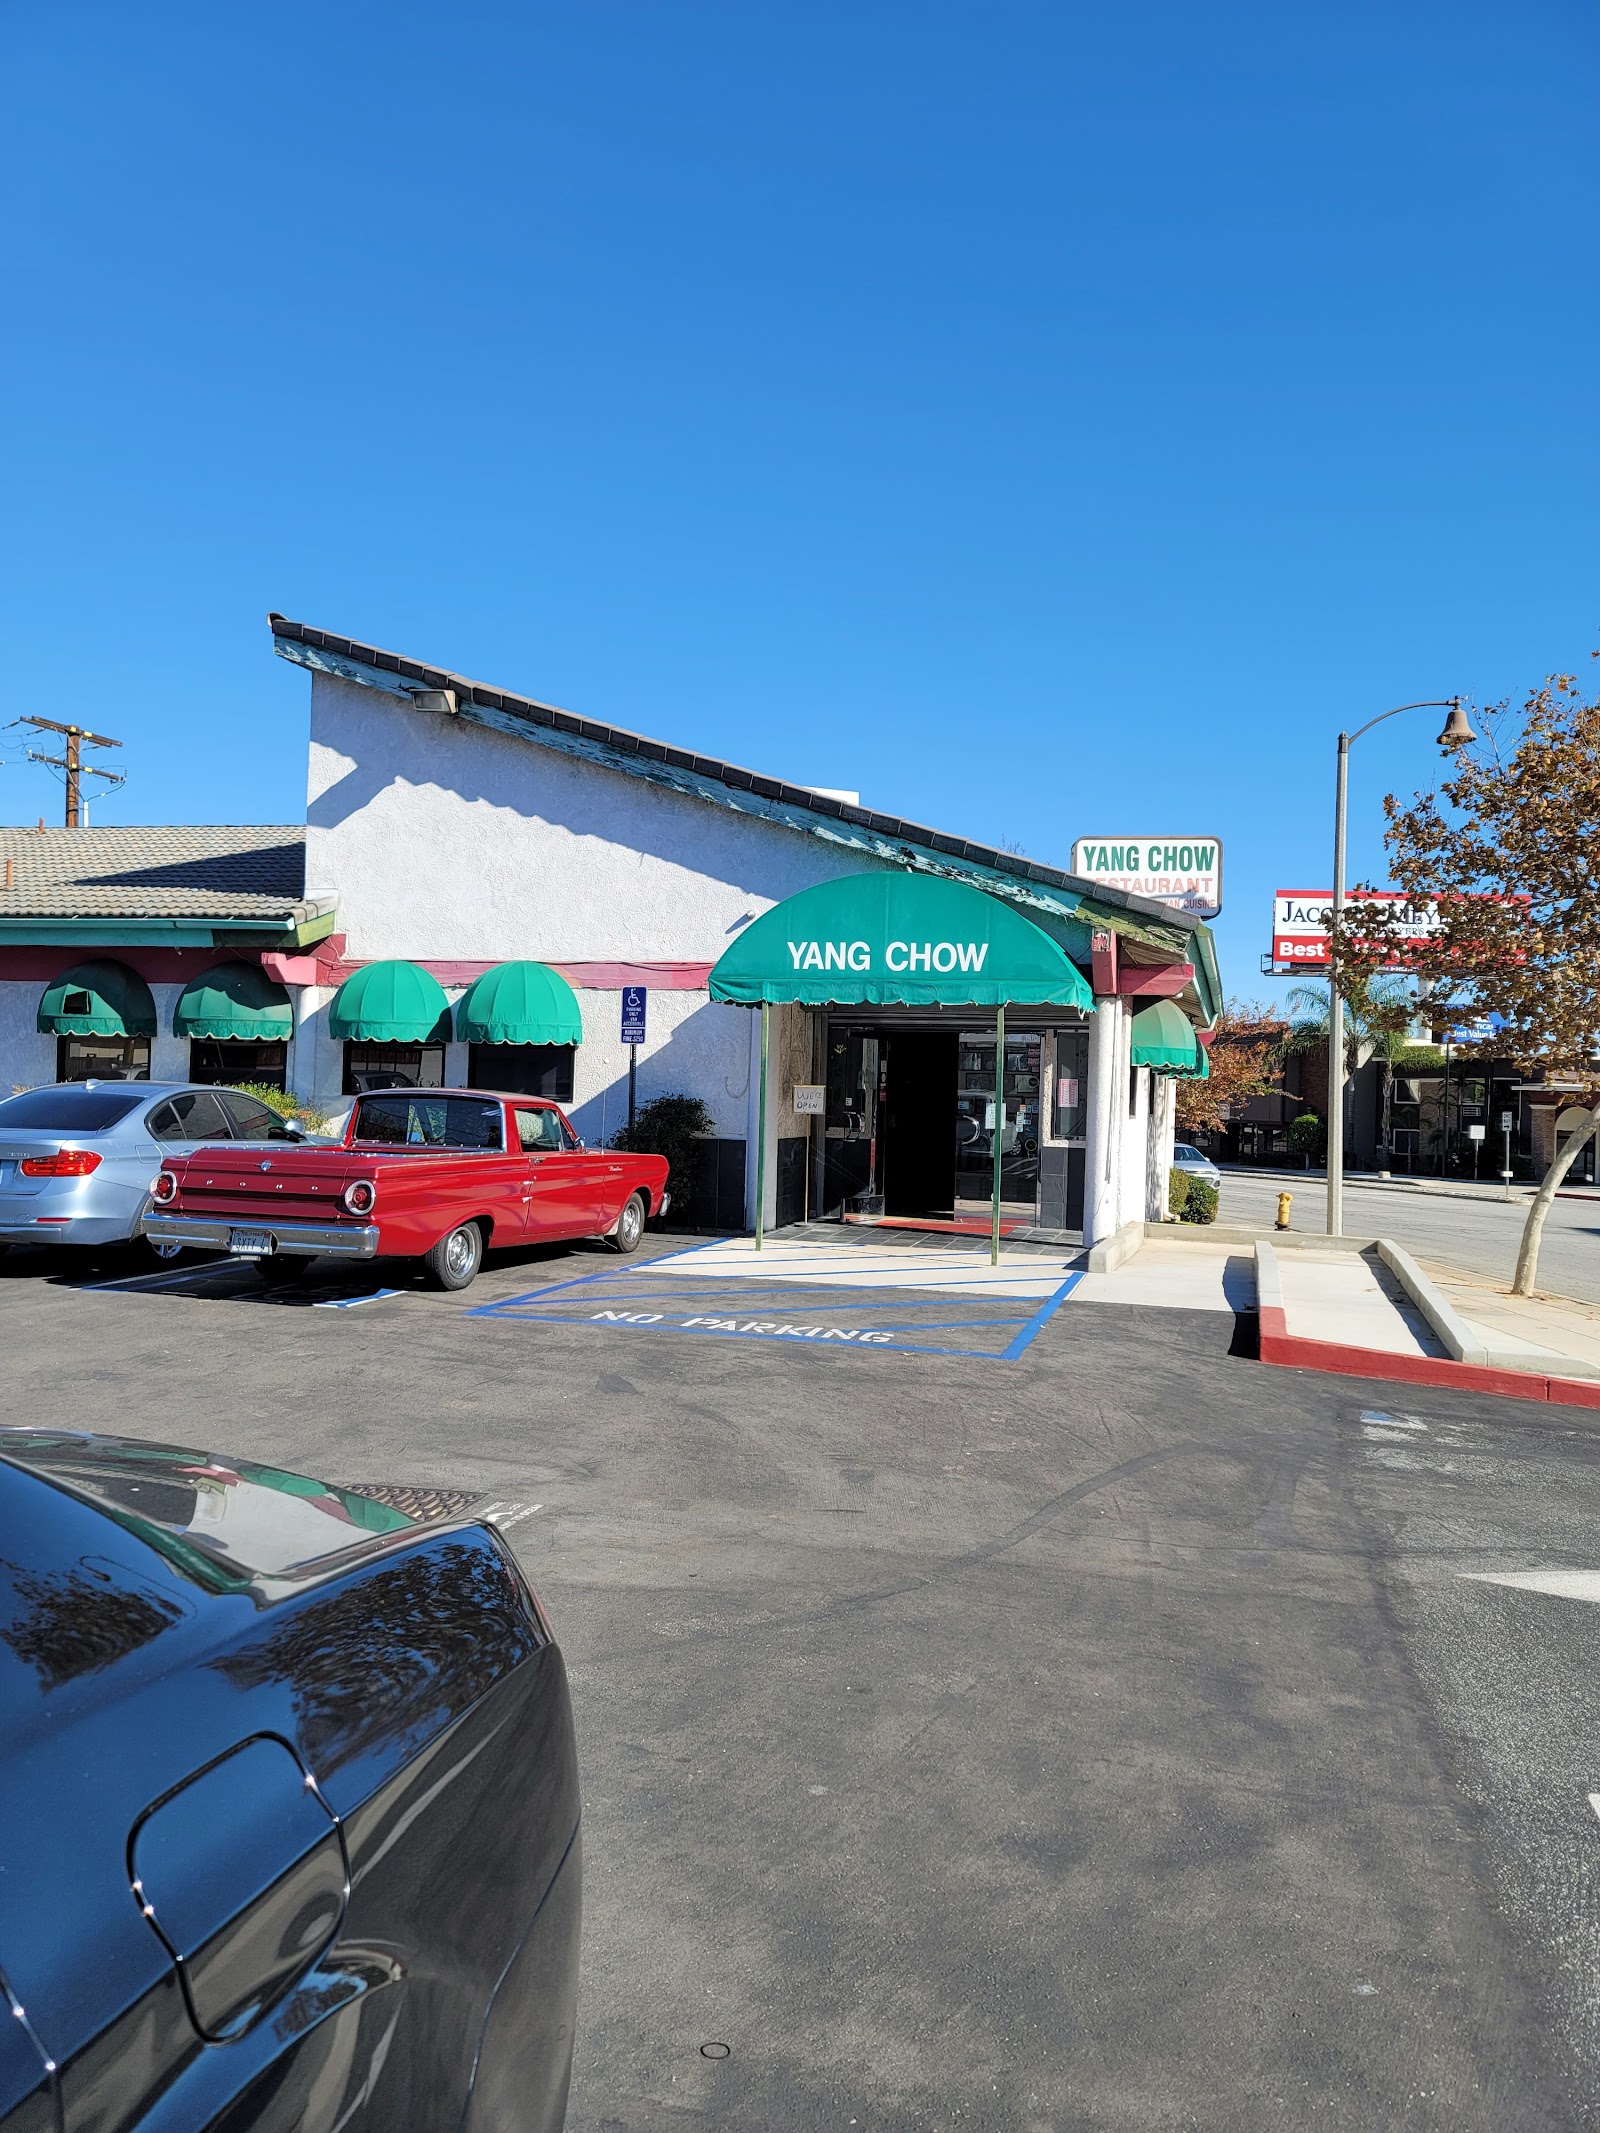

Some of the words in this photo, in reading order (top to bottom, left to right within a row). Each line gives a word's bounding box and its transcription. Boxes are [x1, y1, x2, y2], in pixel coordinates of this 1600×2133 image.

[1083, 846, 1139, 871] YANG
[1148, 846, 1215, 871] CHOW
[1095, 877, 1213, 893] STAURANT
[1183, 900, 1216, 909] CUISINE
[1282, 900, 1334, 922] JAC
[787, 941, 871, 971] YANG
[885, 941, 989, 972] CHOW
[1279, 941, 1325, 957] Best
[1468, 1029, 1489, 1038] Value
[796, 1101, 818, 1110] OPEN
[590, 1310, 665, 1324] NO
[681, 1317, 895, 1343] PARKING
